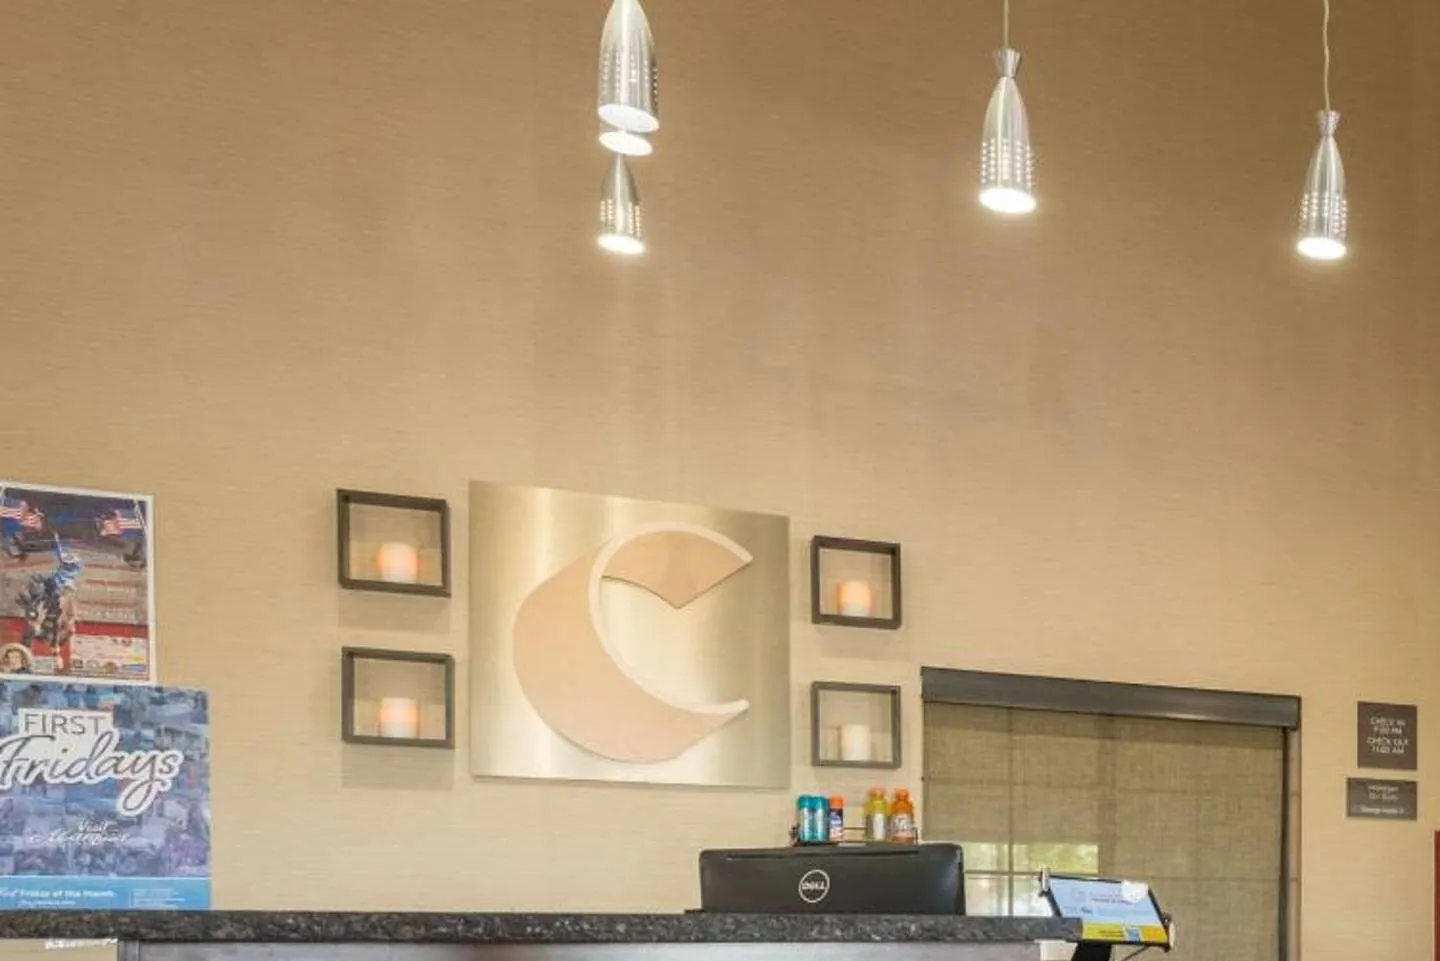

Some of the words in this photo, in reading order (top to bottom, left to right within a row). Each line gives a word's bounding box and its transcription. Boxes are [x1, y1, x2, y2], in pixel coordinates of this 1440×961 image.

[25, 713, 106, 736] FIRST
[1366, 736, 1392, 746] CHECK
[0, 730, 176, 811] Fridays
[802, 881, 825, 890] DELL
